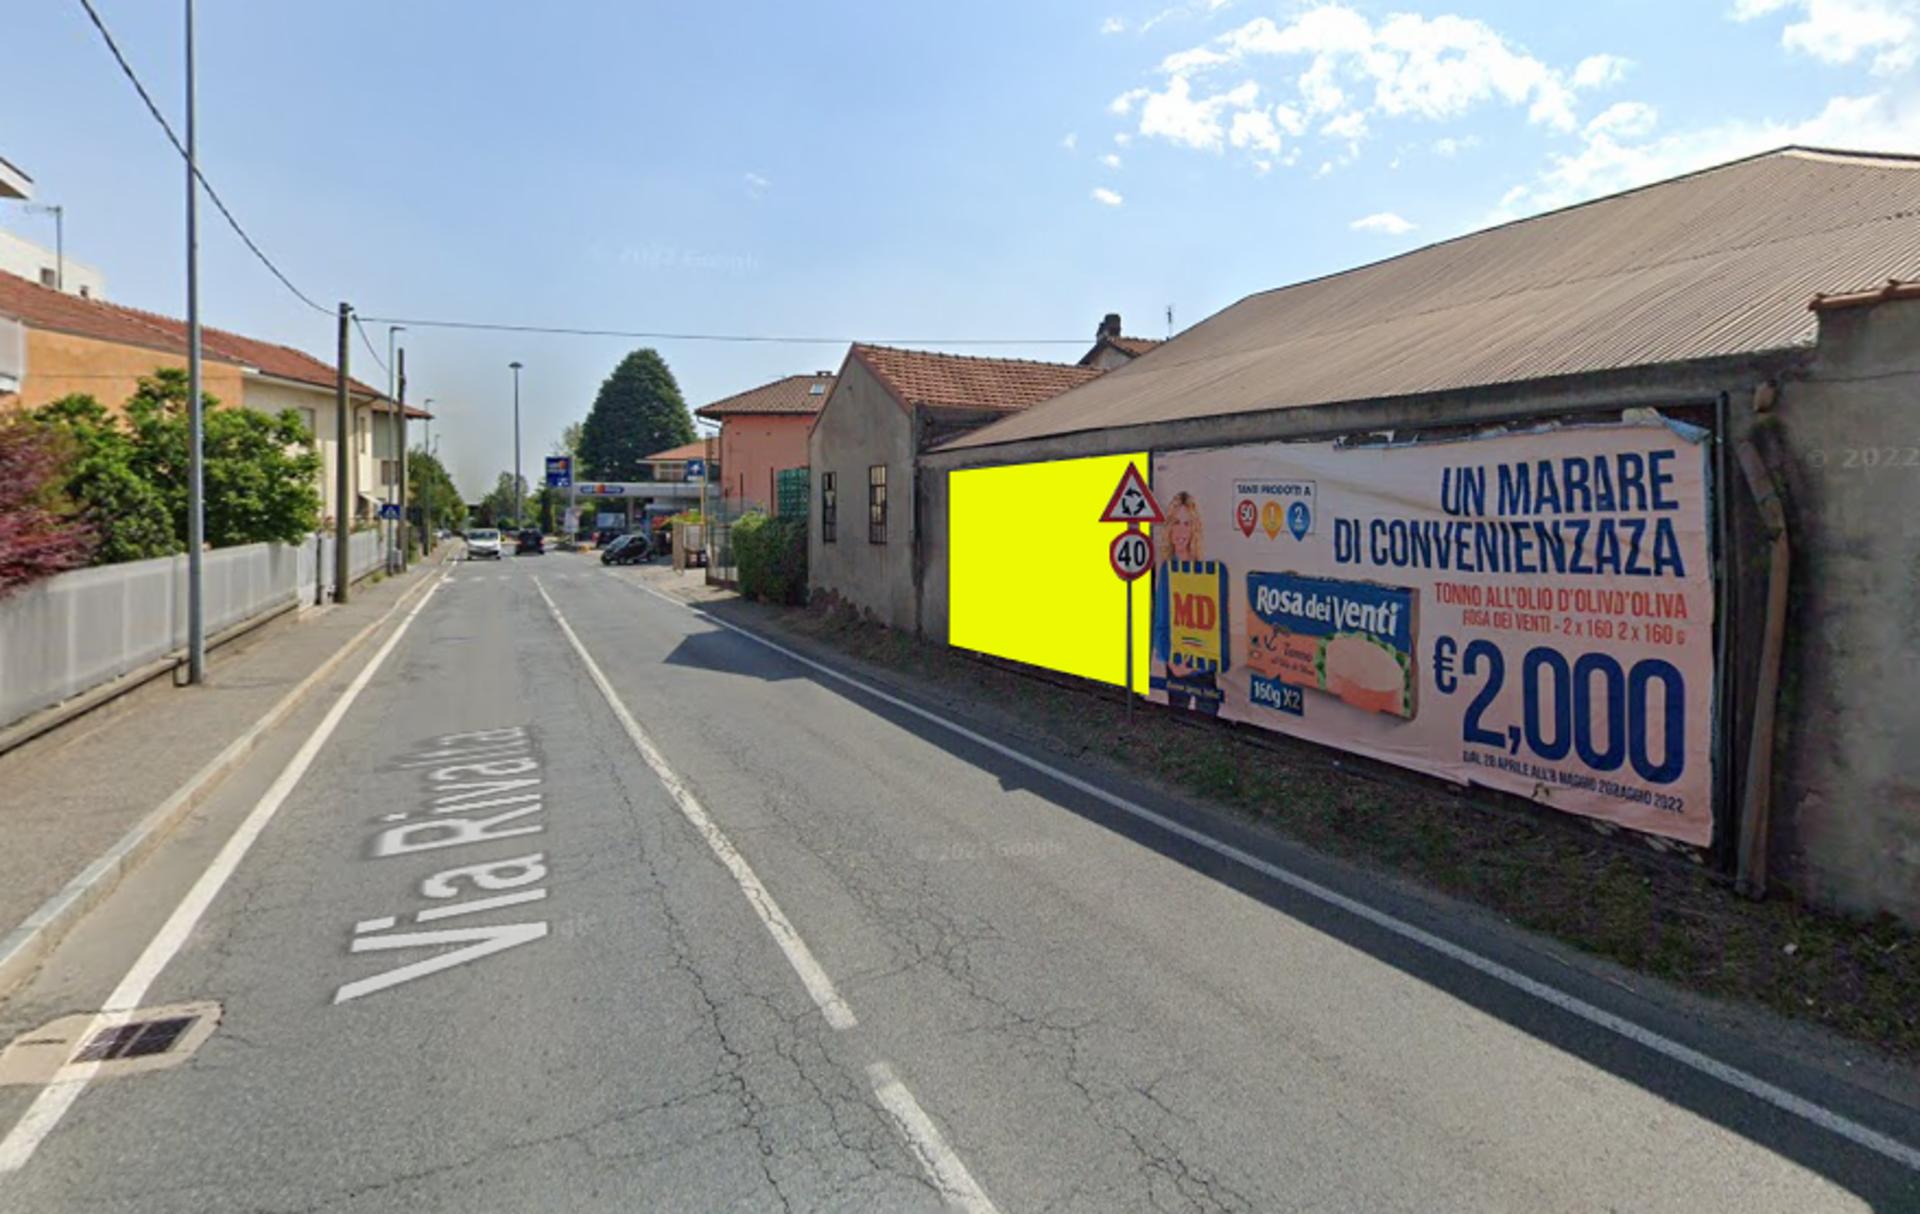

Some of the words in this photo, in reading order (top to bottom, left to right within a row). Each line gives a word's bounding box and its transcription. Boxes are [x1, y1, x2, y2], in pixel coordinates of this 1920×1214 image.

[1304, 486, 1312, 497] A
[1440, 465, 1486, 517] UN
[1118, 540, 1146, 567] 40
[1334, 517, 1361, 565] DI
[1370, 516, 1686, 578] CONVENIENZAZA
[1173, 591, 1217, 631] MD
[1257, 585, 1304, 617] Rosa
[1305, 592, 1331, 622] dei
[1331, 595, 1400, 636] Venti
[1434, 582, 1482, 608] TONNO
[1486, 585, 1555, 611] ALL'OLIO
[1515, 612, 1551, 634] VENTI
[1563, 617, 1572, 635] 2
[1586, 619, 1613, 639] 160
[1618, 621, 1628, 641] 2
[1645, 624, 1673, 645] 160
